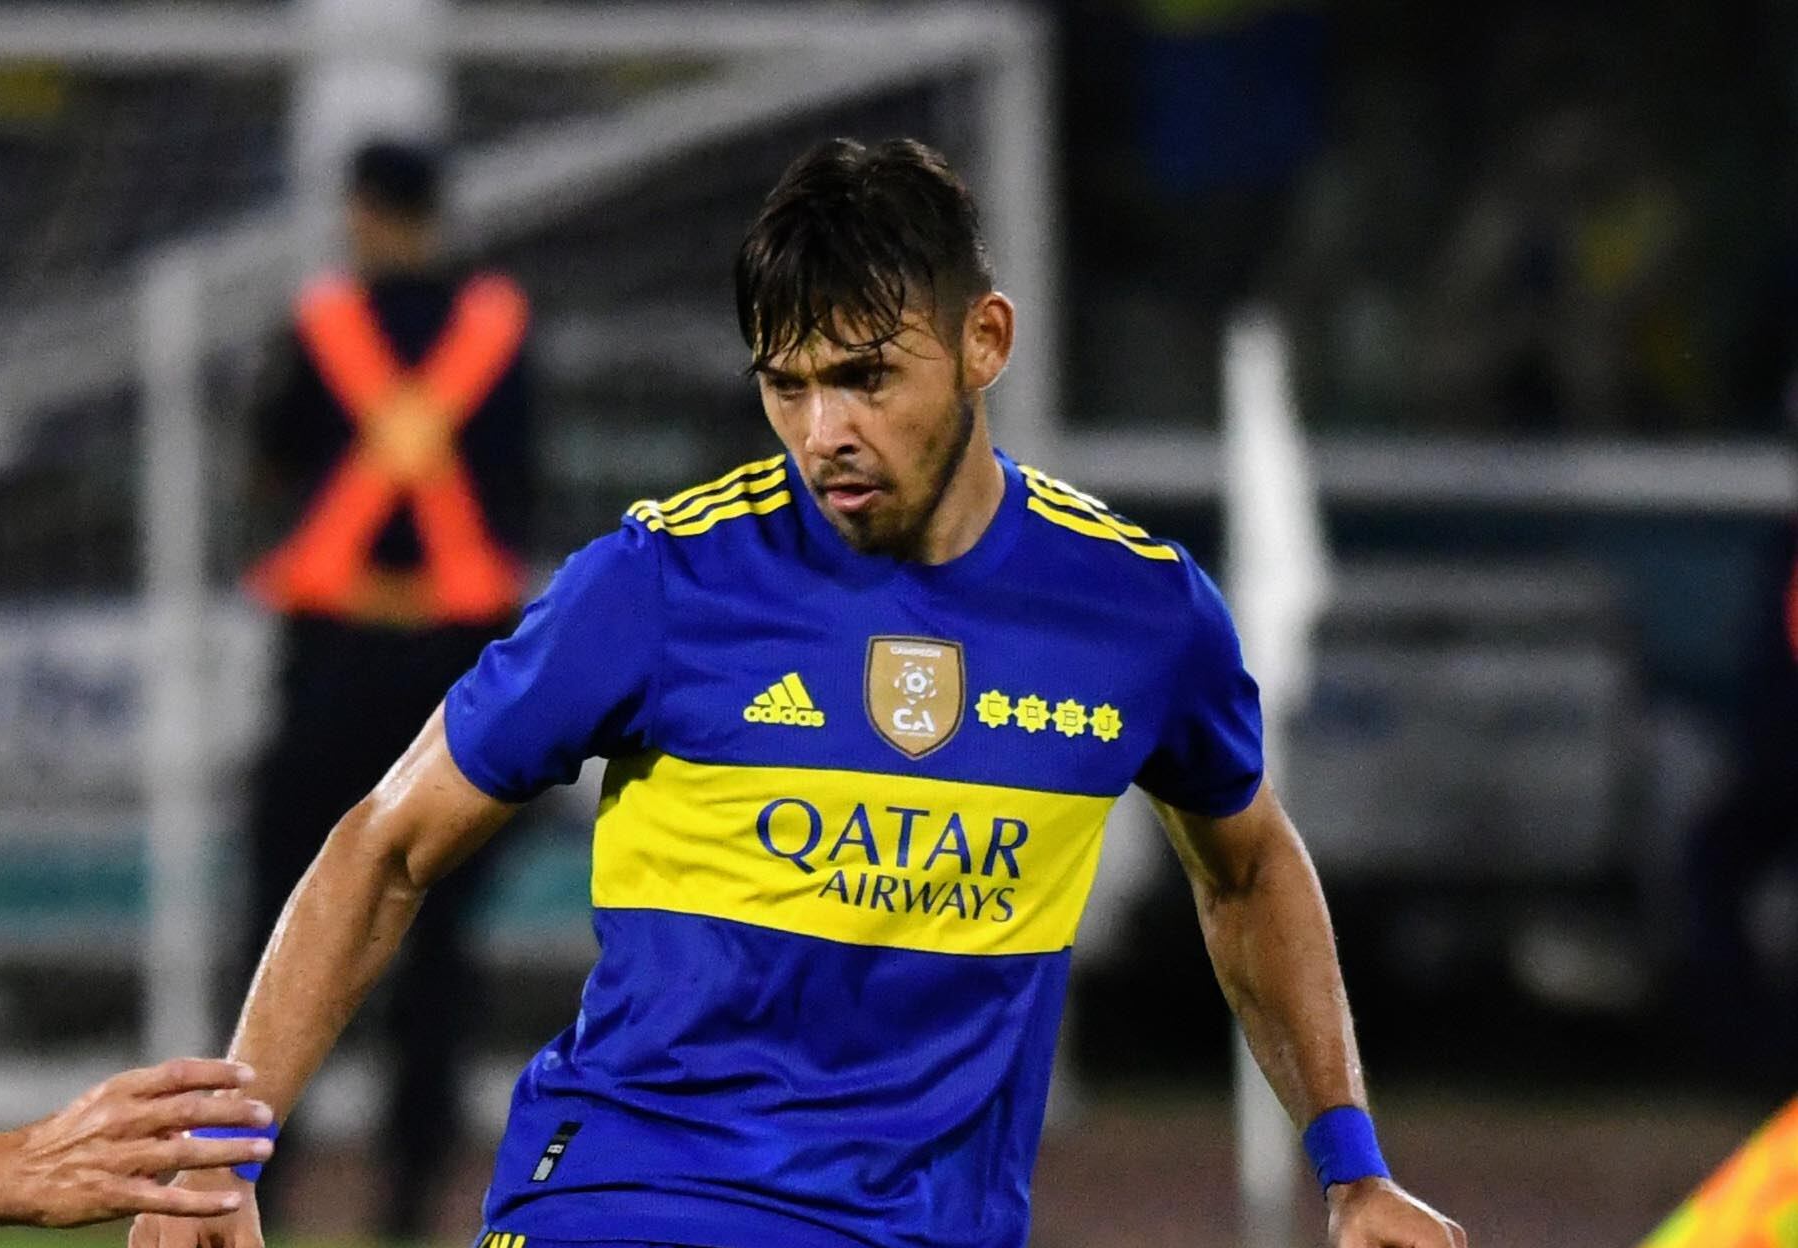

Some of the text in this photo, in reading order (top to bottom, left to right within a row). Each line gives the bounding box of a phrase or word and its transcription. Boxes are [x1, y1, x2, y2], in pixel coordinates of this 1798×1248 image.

[743, 704, 825, 728] adidas
[756, 797, 1030, 880] QATAR
[818, 869, 1016, 923] AIRWAYS
